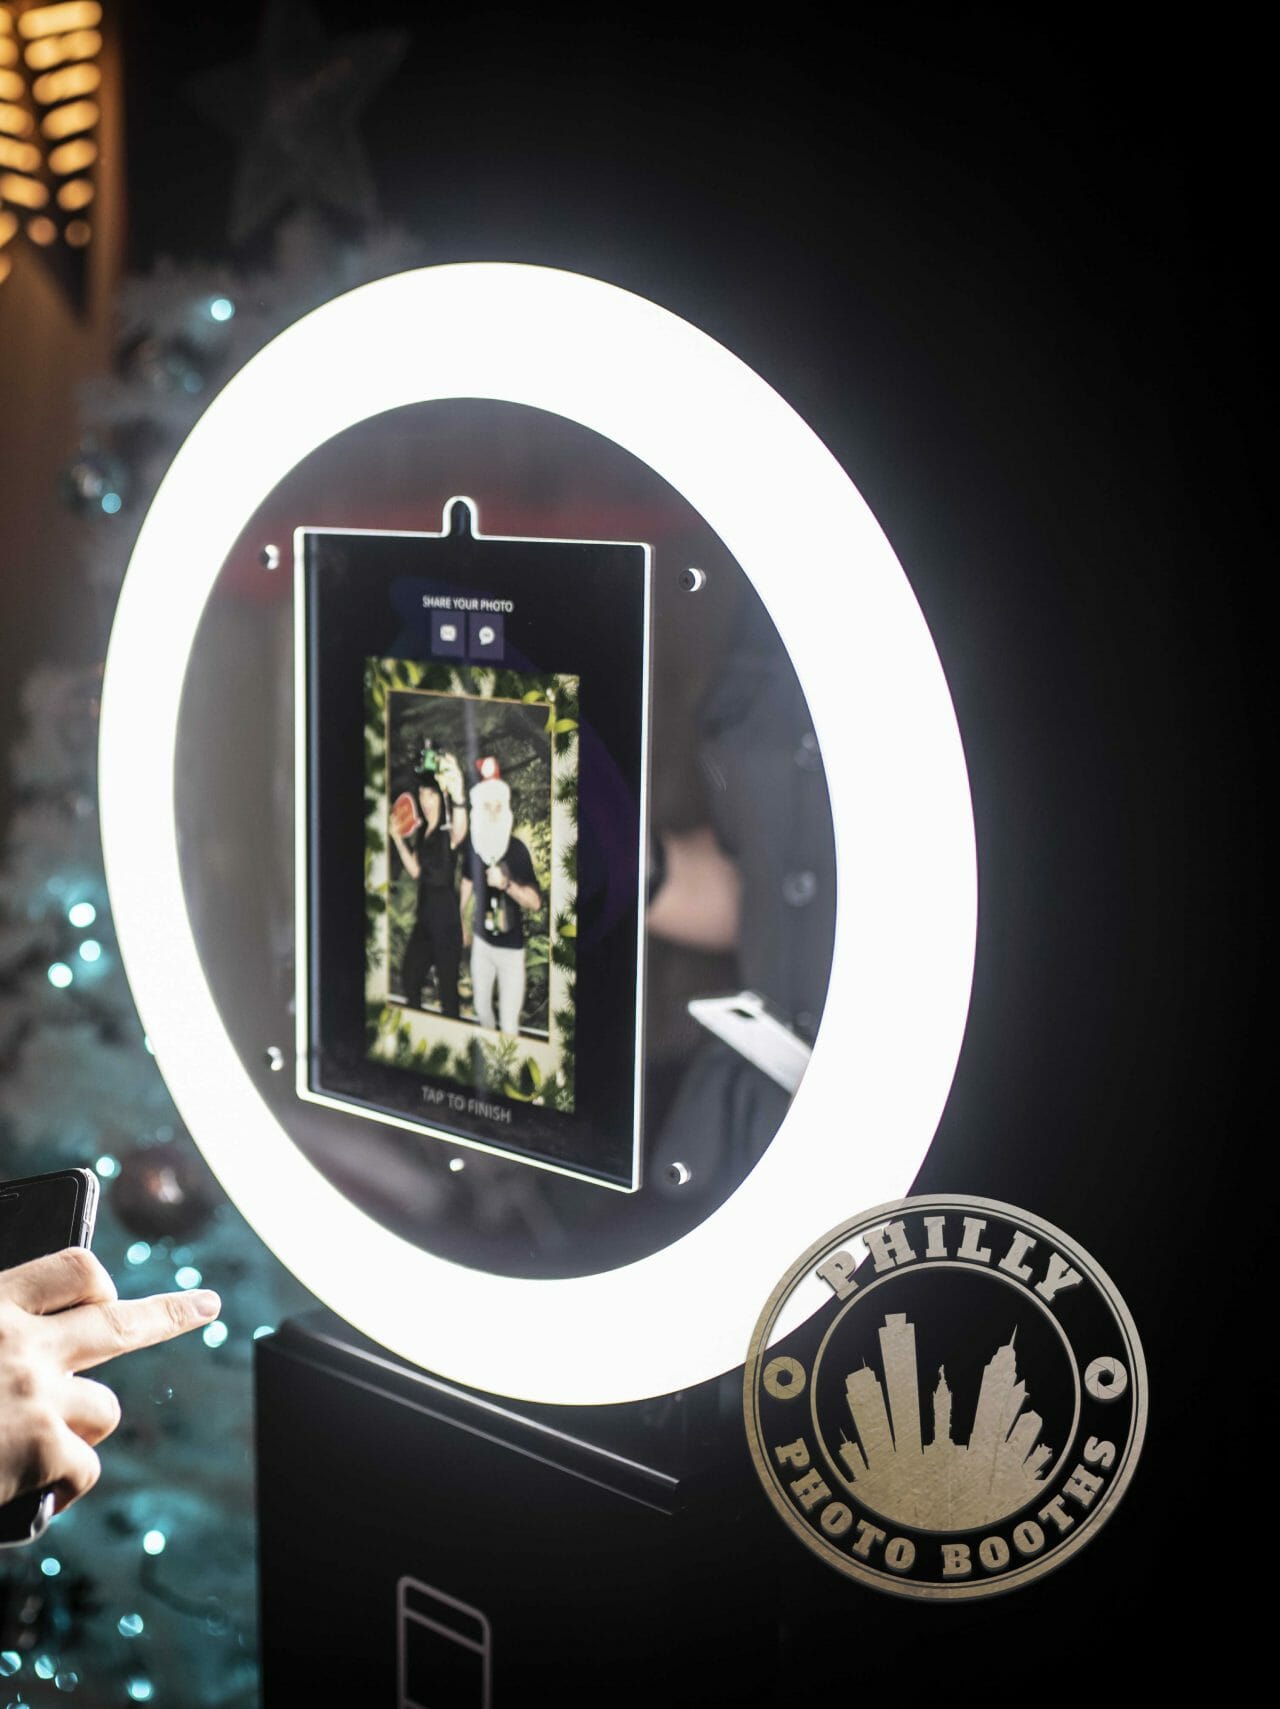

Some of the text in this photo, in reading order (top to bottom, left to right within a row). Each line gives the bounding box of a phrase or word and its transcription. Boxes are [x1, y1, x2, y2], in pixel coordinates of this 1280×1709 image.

[422, 594, 514, 613] SHARE YOUR PHOTO
[422, 1085, 511, 1123] TAP TO FINISH
